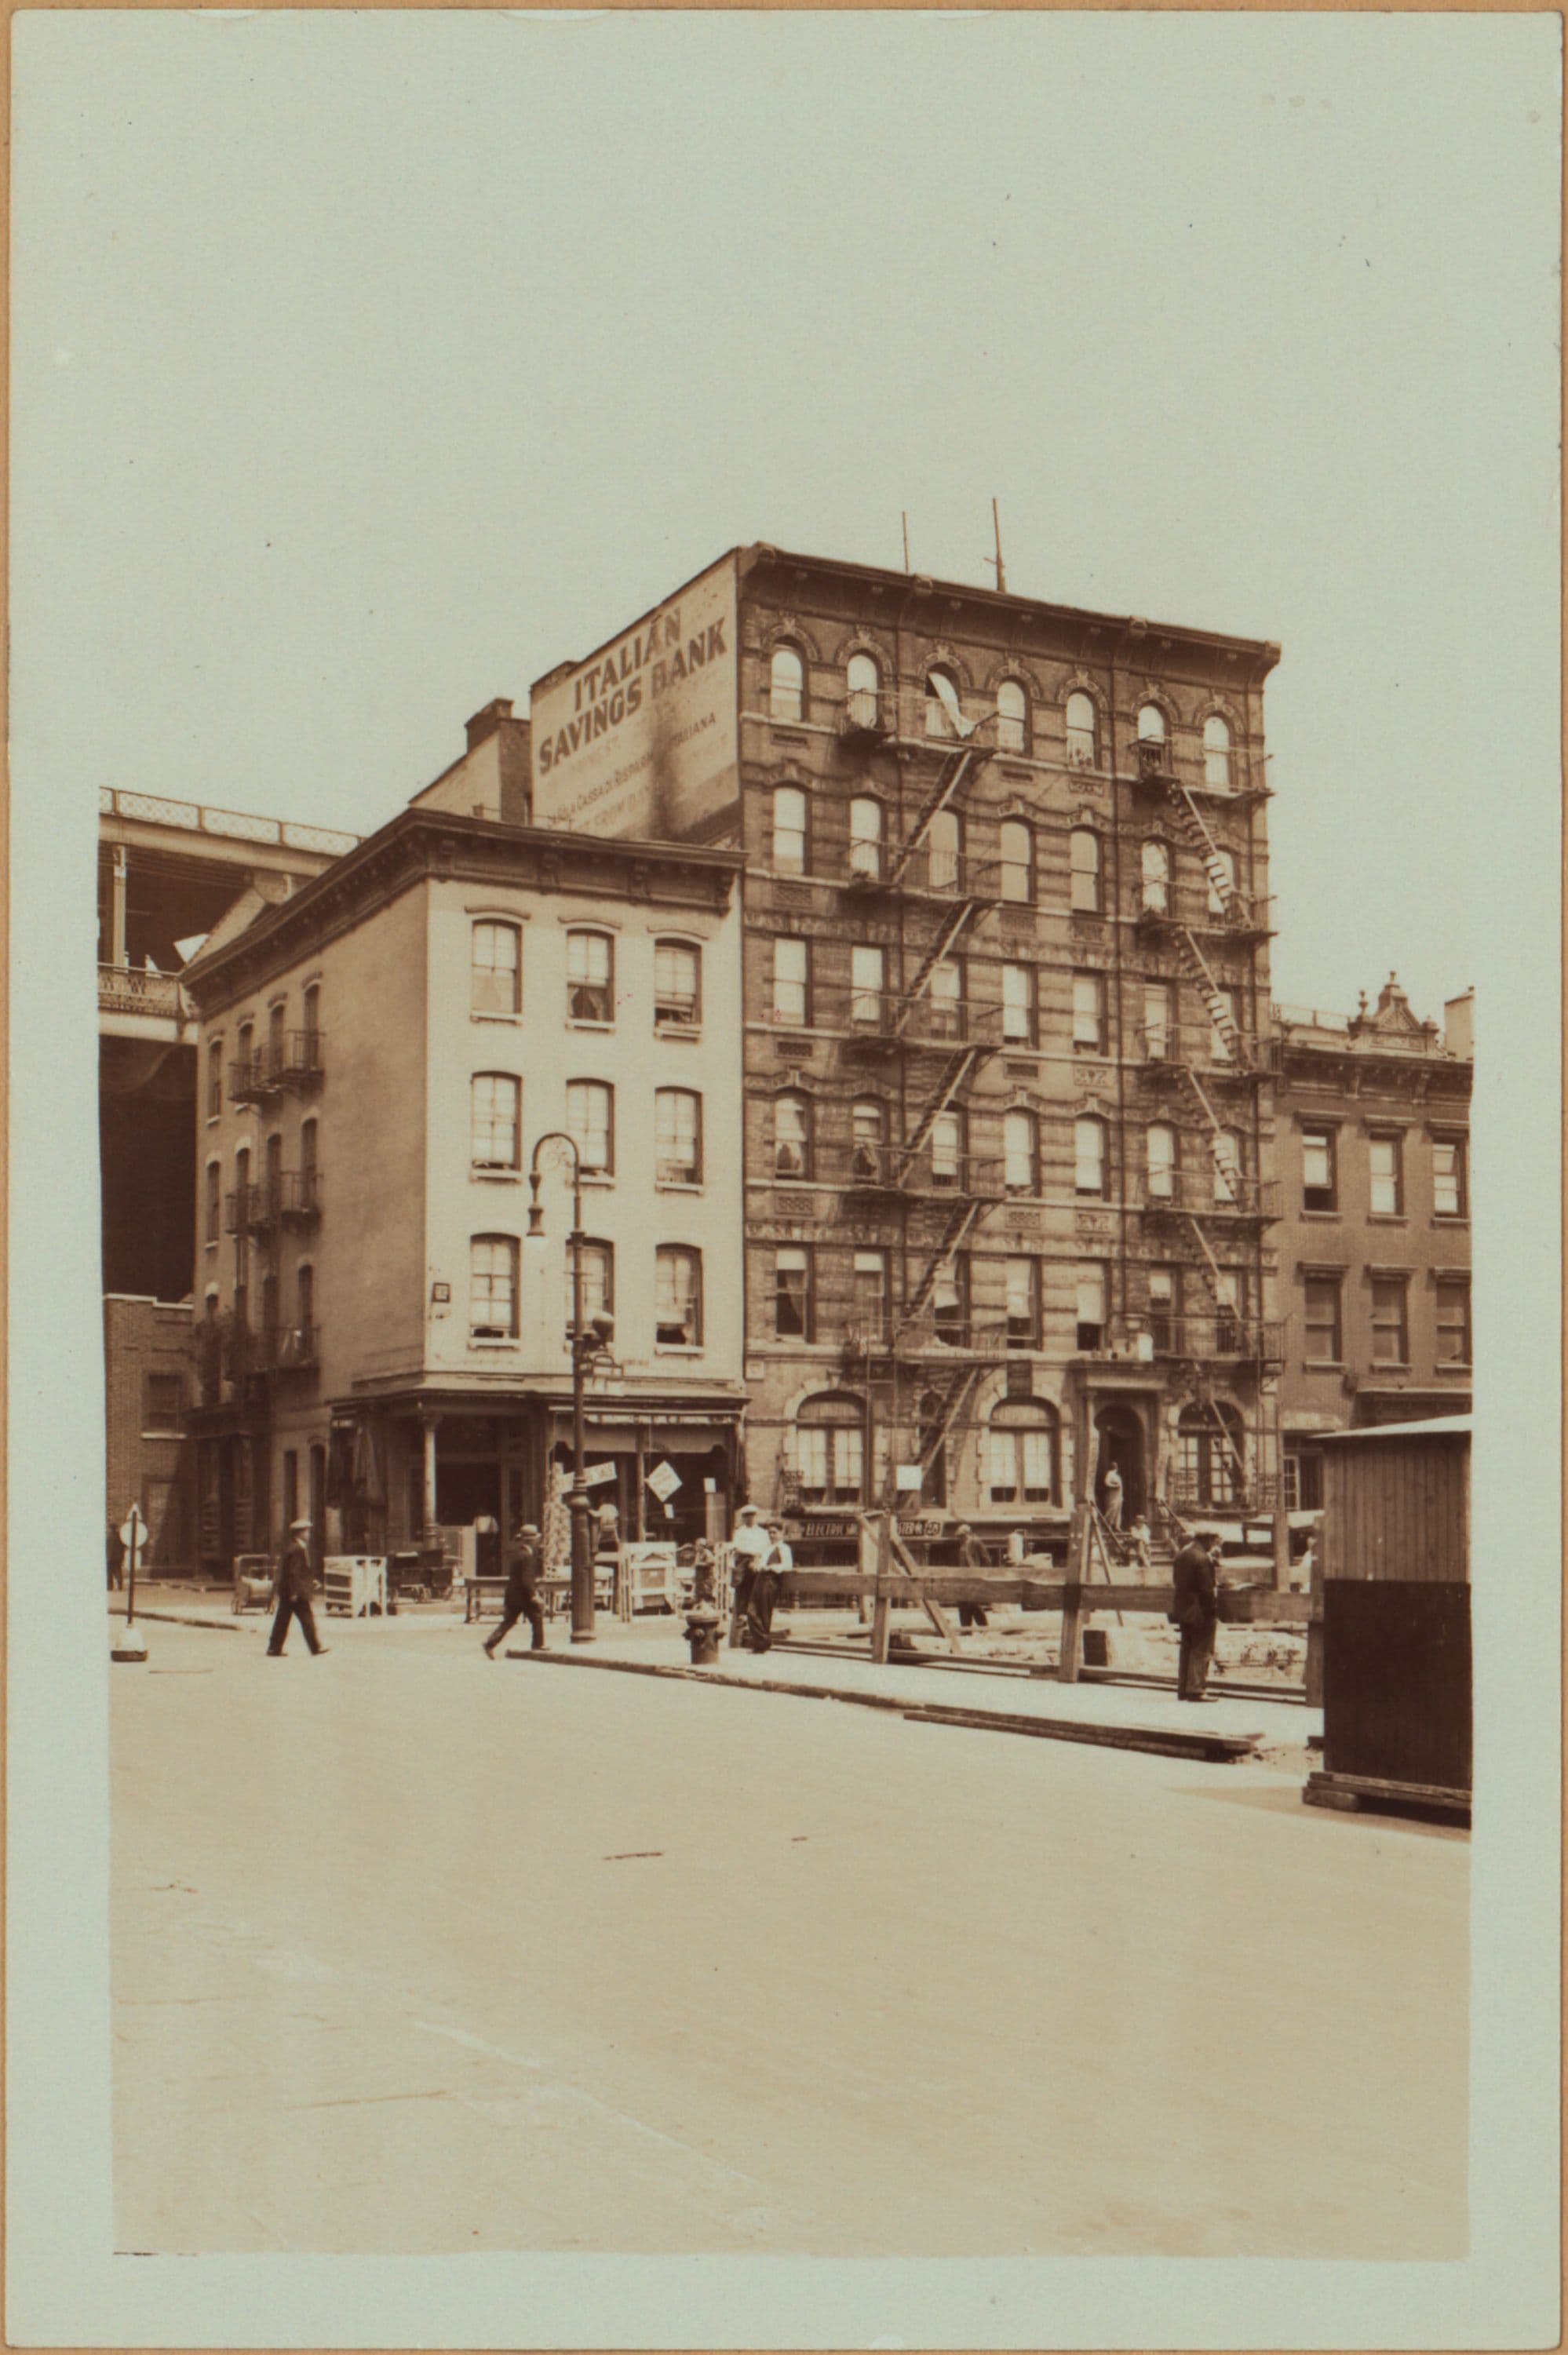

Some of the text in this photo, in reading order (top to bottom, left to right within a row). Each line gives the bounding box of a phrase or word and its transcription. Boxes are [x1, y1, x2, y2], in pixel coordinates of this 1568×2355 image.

[539, 676, 643, 776] SAVINGS
[651, 616, 727, 700] BANK
[574, 606, 681, 712] ITALIAN
